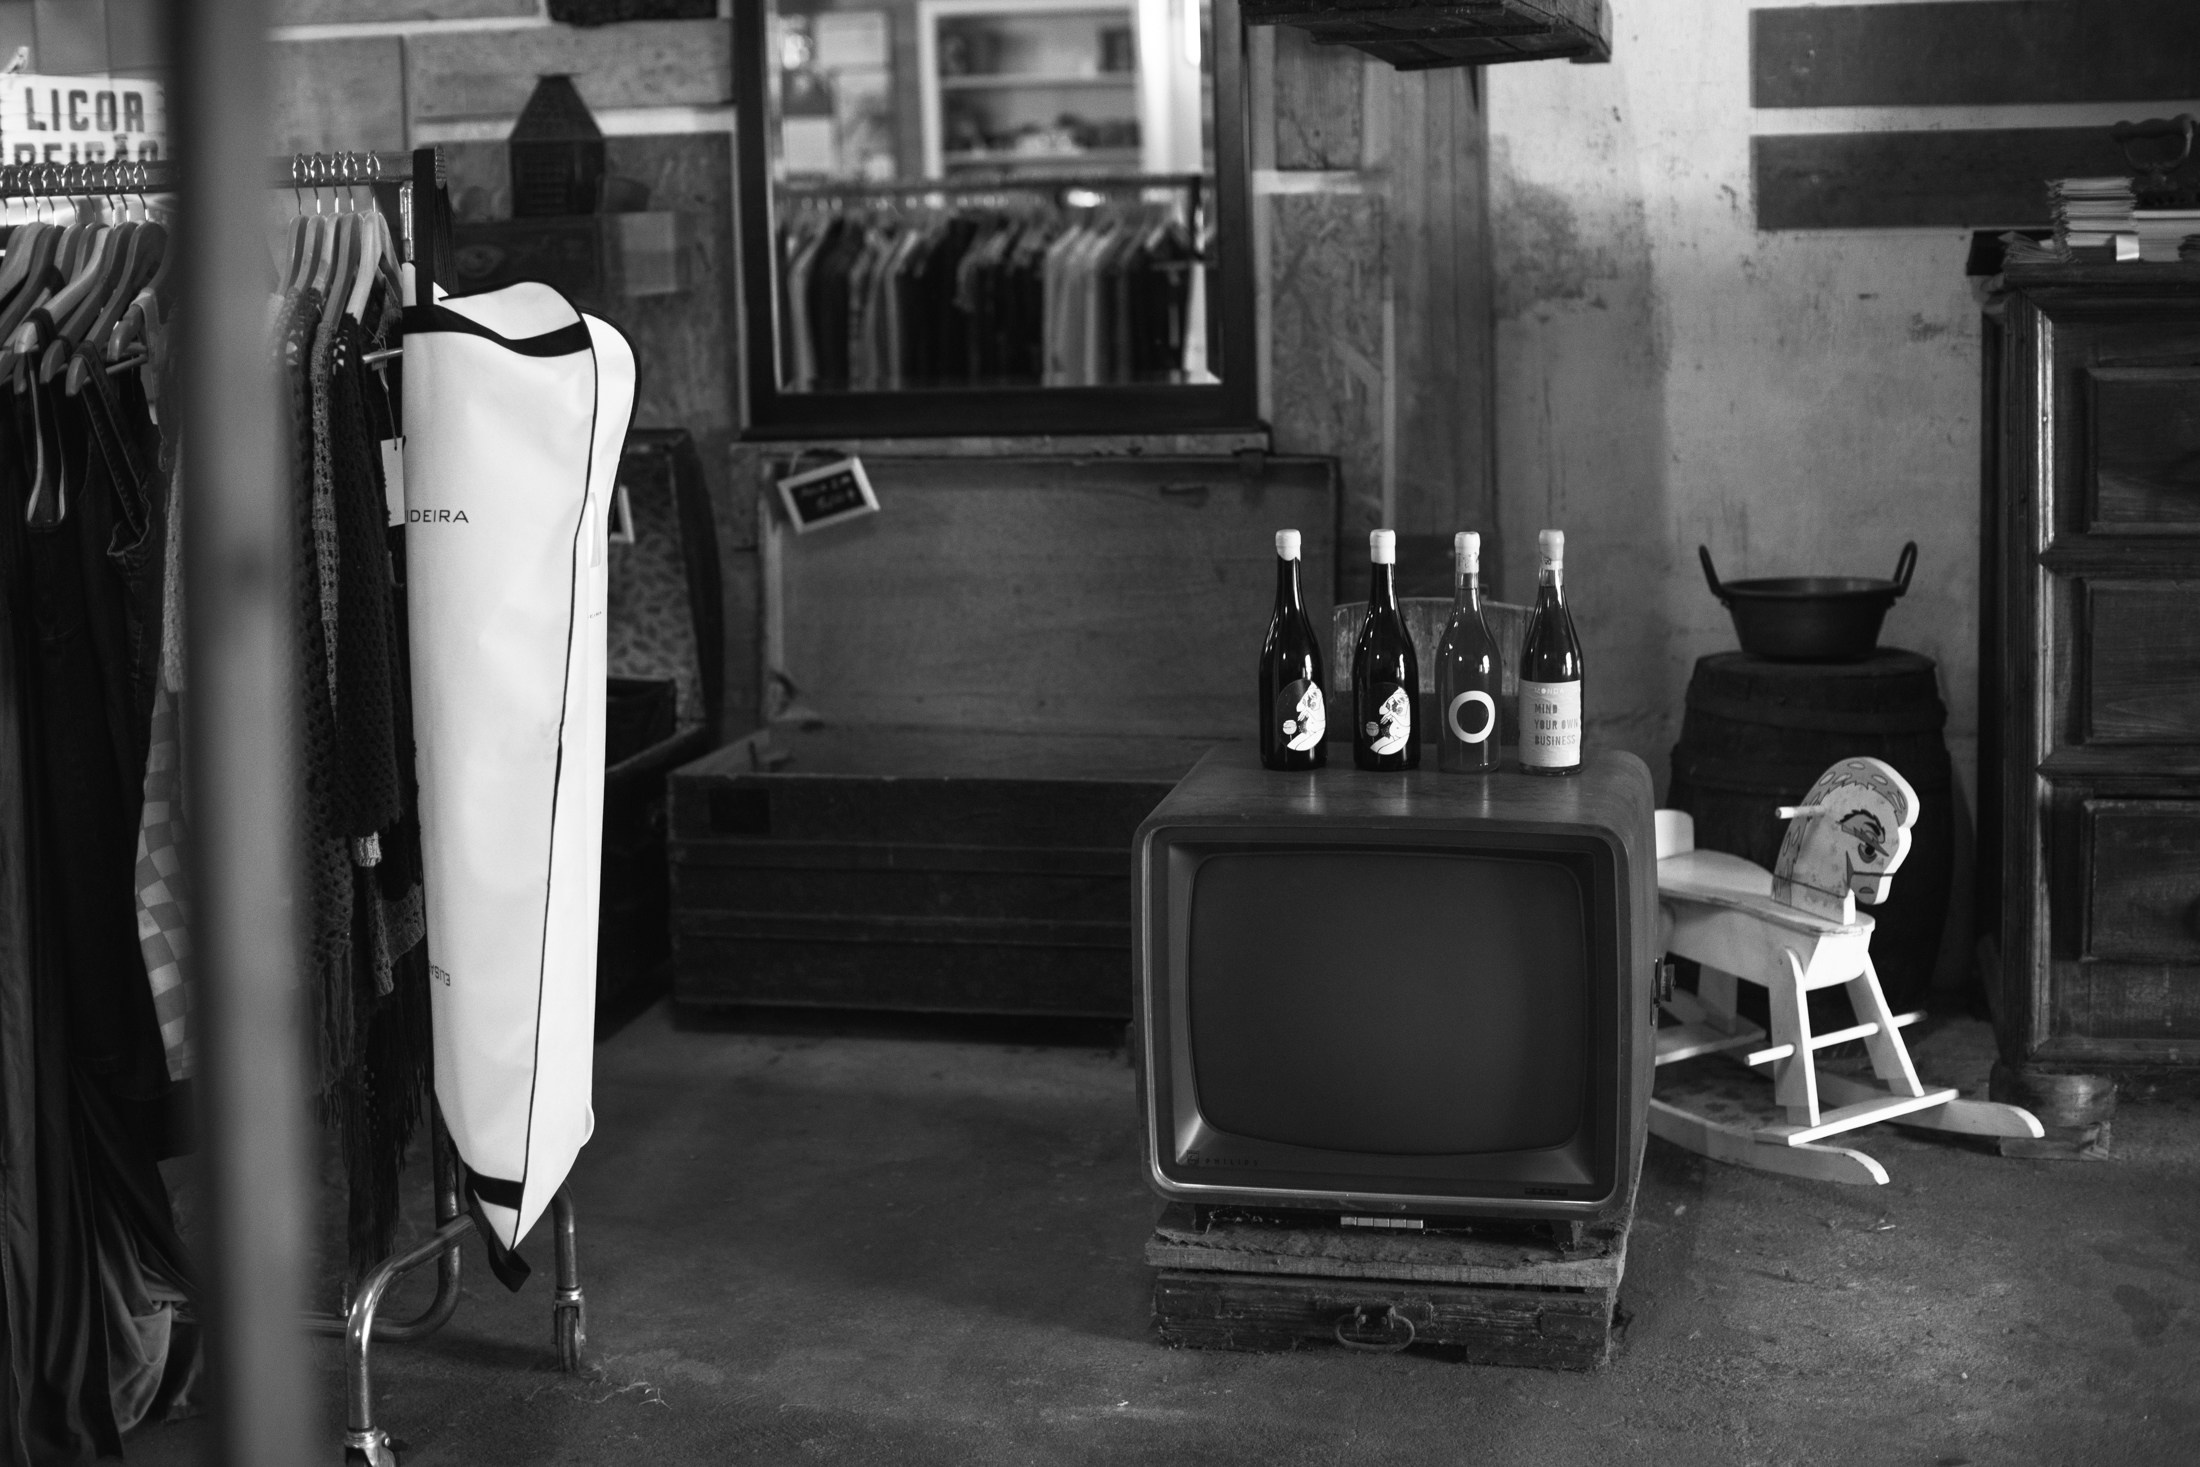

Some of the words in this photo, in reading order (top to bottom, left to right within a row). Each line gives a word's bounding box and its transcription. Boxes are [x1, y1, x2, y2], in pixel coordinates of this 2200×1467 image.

[25, 86, 144, 132] LICOR
[1534, 703, 1558, 714] MIND
[1534, 719, 1558, 730] YOUR
[1561, 719, 1579, 730] OWN
[1534, 735, 1576, 746] BUSINESS
